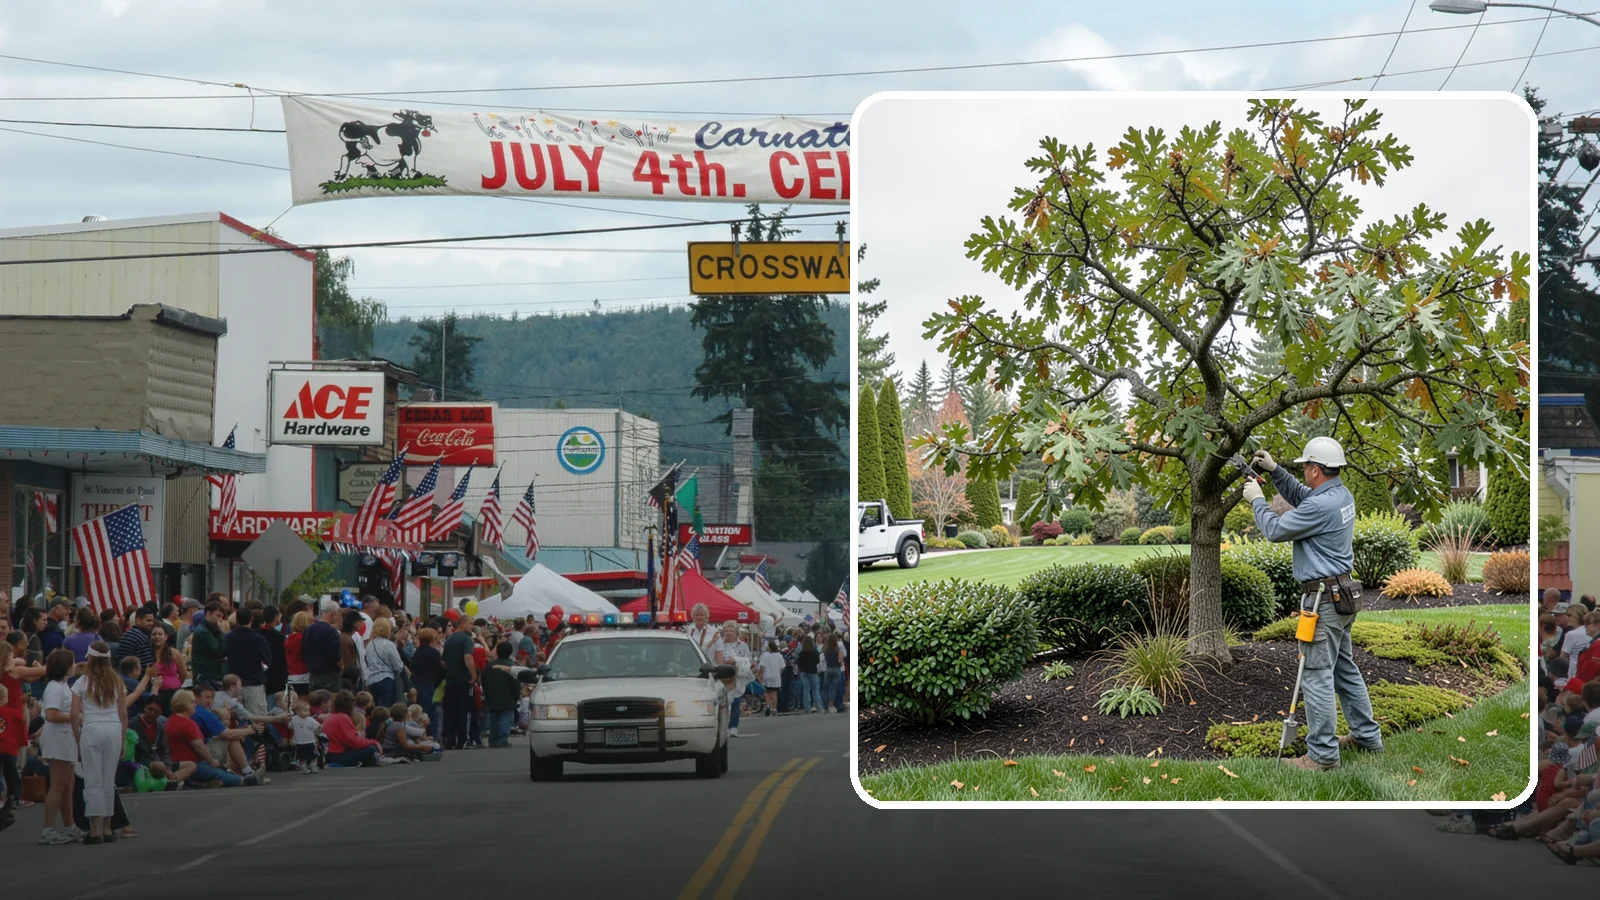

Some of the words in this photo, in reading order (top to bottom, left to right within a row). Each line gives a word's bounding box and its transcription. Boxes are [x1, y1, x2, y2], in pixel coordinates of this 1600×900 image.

[481, 141, 605, 192] JULY
[632, 150, 746, 197] 4th.
[697, 254, 850, 280] CROSSWA
[283, 380, 373, 420] ACE
[406, 409, 452, 421] CEDAR
[283, 420, 371, 436] Hardware
[416, 428, 477, 447] Coca-Cola
[95, 485, 124, 495] Vincent
[126, 485, 136, 494] de
[138, 486, 155, 495] Paul
[688, 526, 741, 535] CRNATION
[699, 535, 730, 543] GLASS
